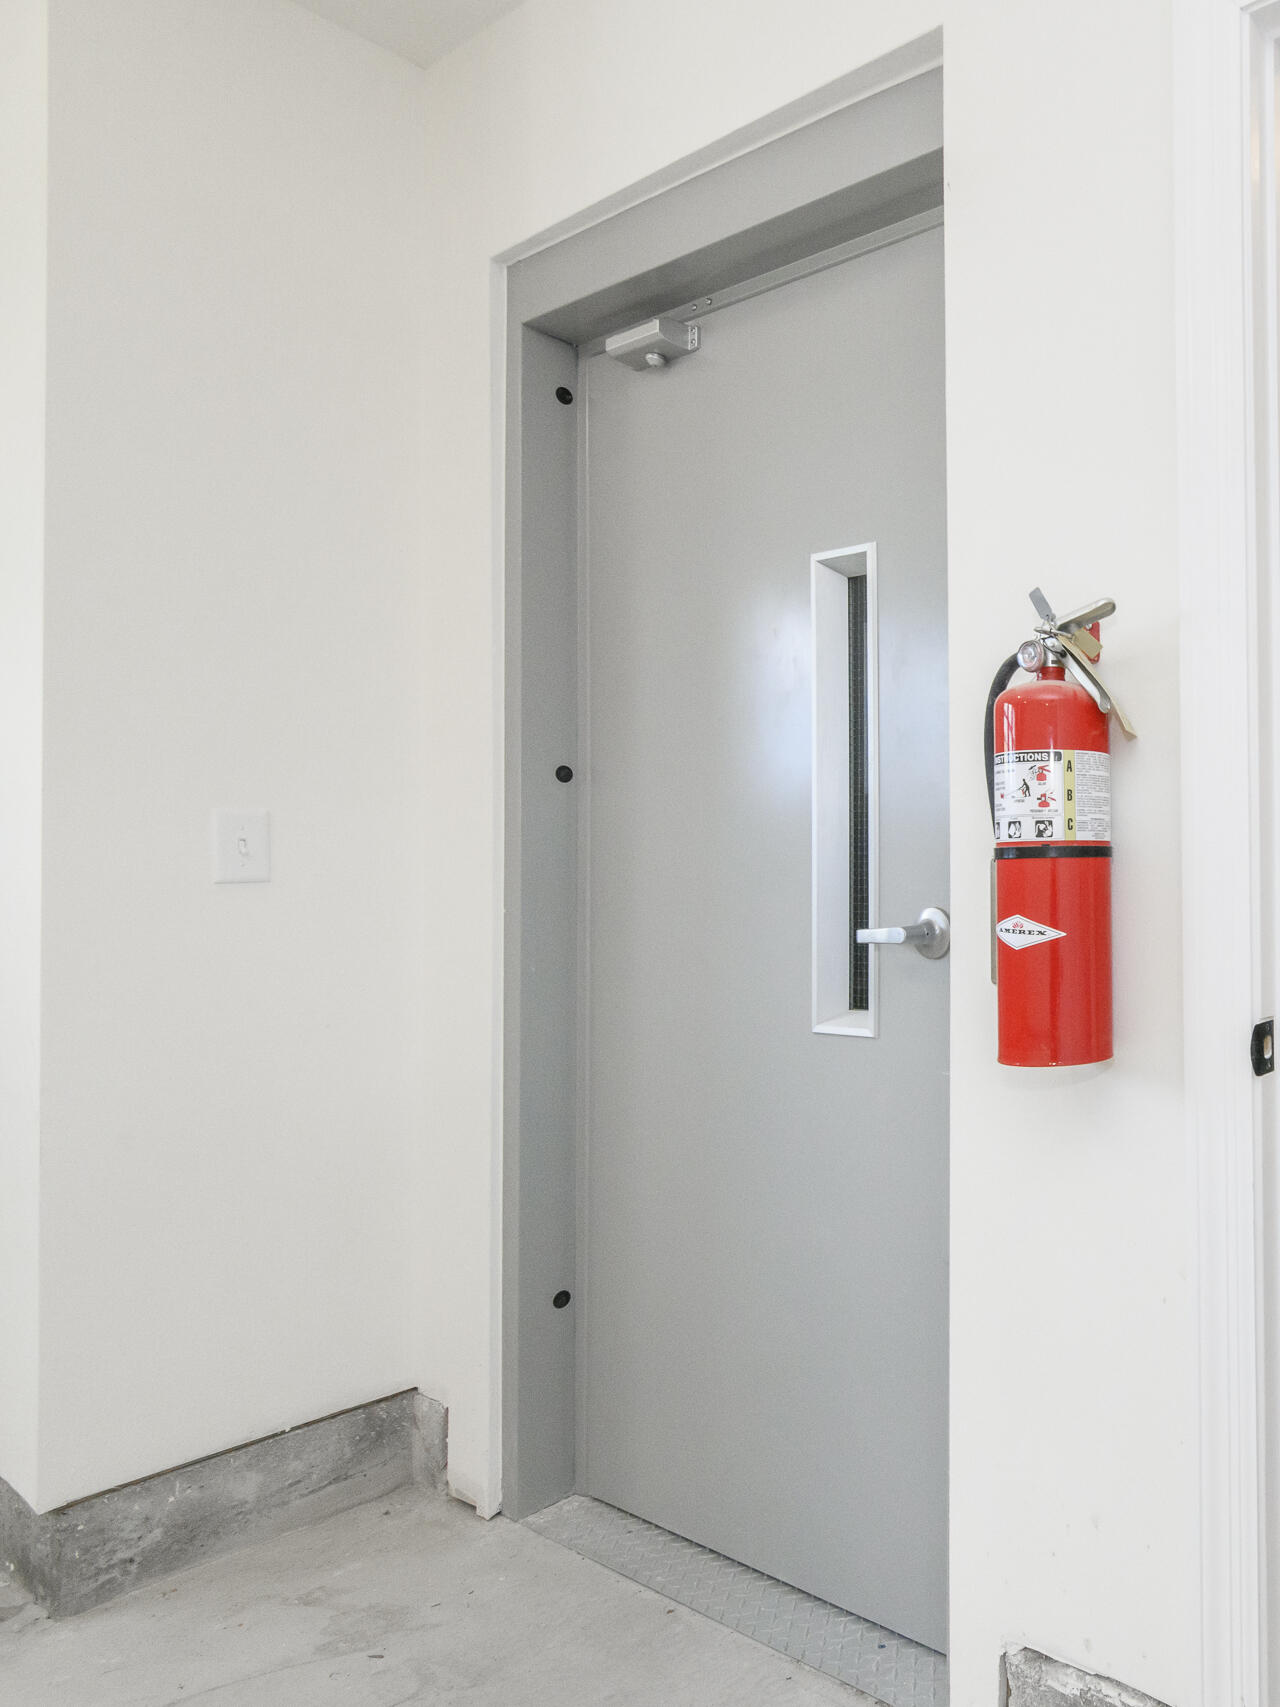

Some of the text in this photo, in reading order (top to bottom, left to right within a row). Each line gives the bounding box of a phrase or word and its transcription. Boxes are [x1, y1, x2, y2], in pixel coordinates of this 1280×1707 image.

[1066, 760, 1073, 772] A
[1067, 789, 1073, 801] B
[1067, 818, 1073, 830] C
[1000, 927, 1047, 936] AMEREX
